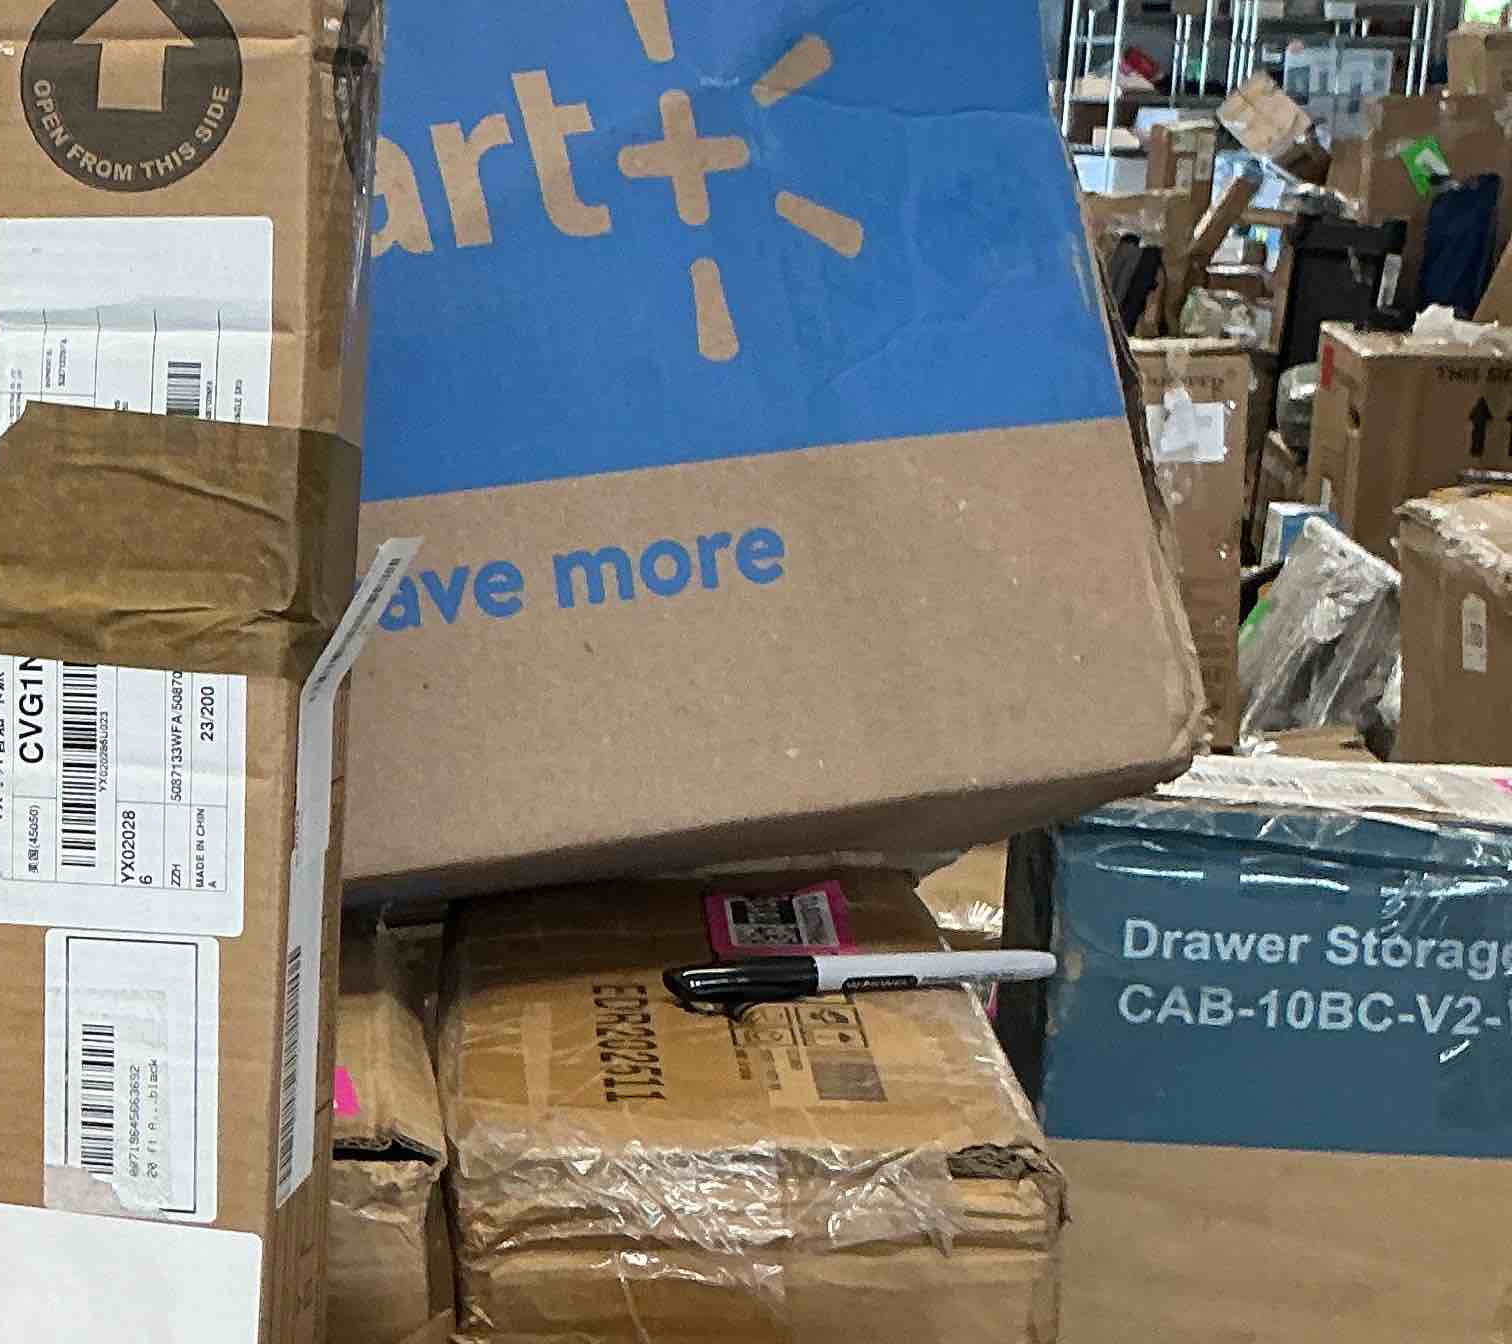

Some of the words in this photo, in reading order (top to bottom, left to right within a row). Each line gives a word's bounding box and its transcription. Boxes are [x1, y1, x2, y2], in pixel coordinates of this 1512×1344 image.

[32, 78, 66, 153] OPEN
[65, 141, 134, 182] FROM
[139, 141, 197, 182] THIS
[193, 84, 230, 146] SIDE
[352, 558, 524, 632] ave
[553, 524, 788, 610] more
[199, 685, 216, 742] 23/200
[120, 810, 136, 884] YX02028
[195, 854, 205, 888] MADE
[139, 874, 153, 886] 6
[1124, 920, 1310, 967] Drawer
[1117, 985, 1512, 1036] CAB-10BC-V2-
